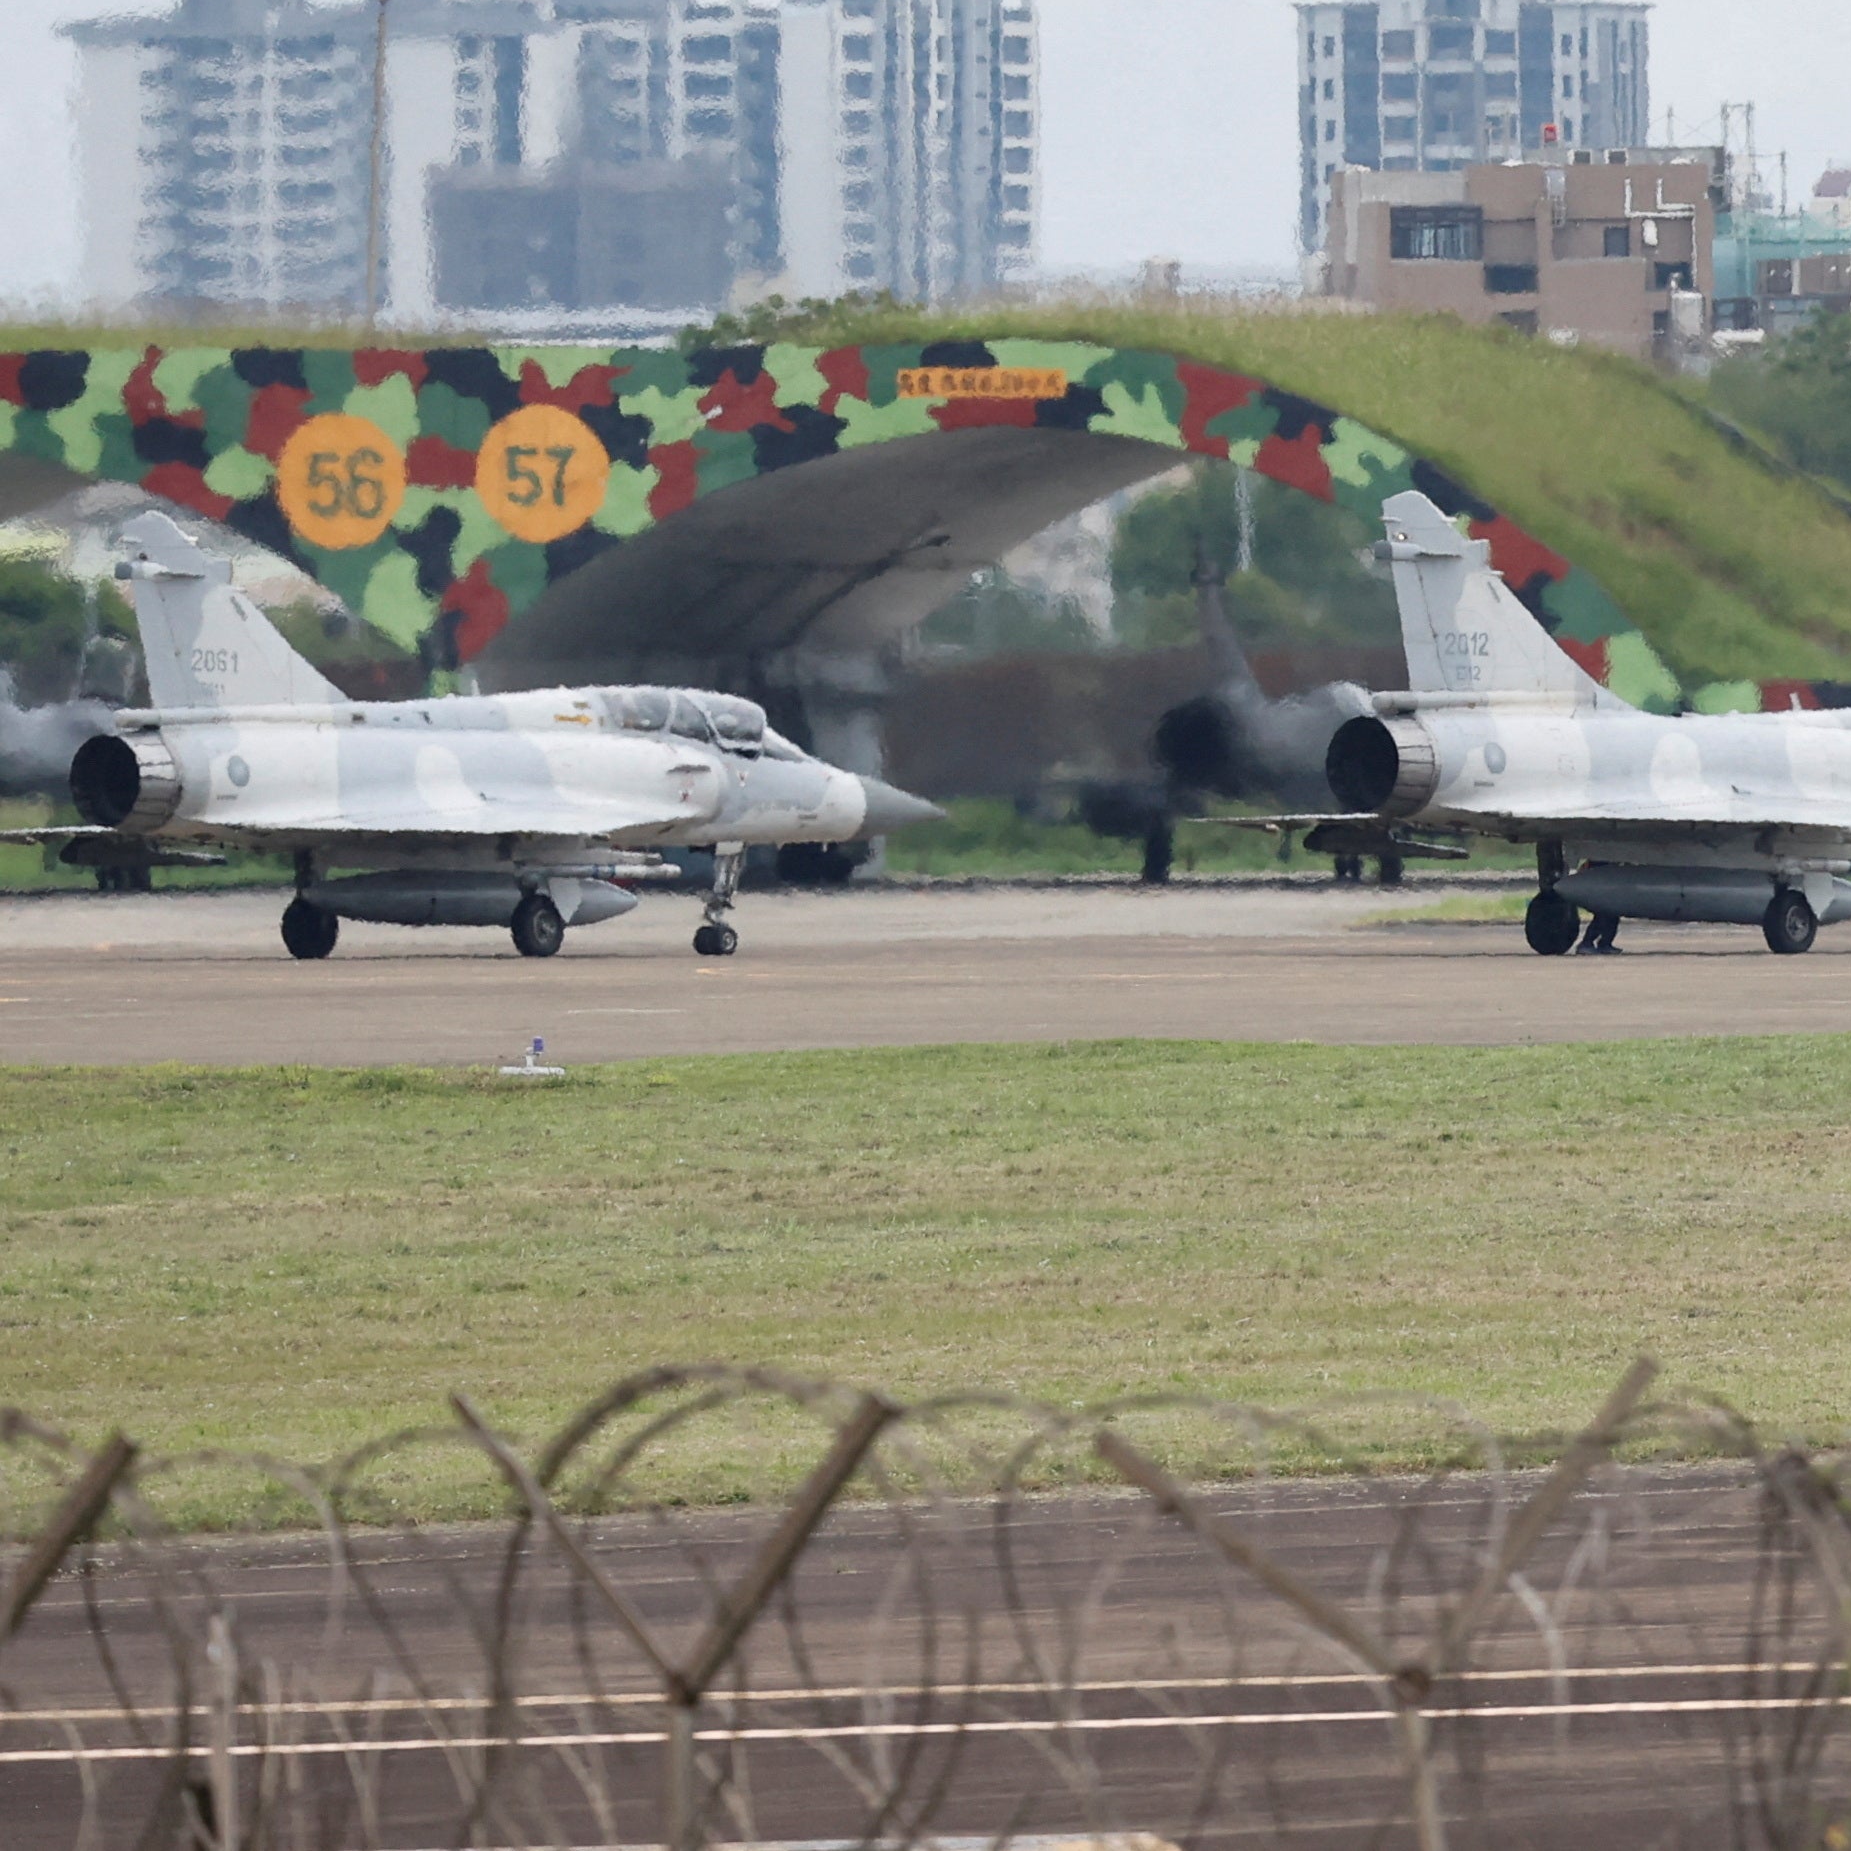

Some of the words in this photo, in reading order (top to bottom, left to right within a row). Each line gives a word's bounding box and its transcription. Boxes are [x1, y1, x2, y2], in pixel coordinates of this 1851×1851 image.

[306, 446, 388, 519] 56
[505, 444, 576, 507] 57
[191, 648, 239, 673] 2061
[1444, 632, 1489, 656] 2012
